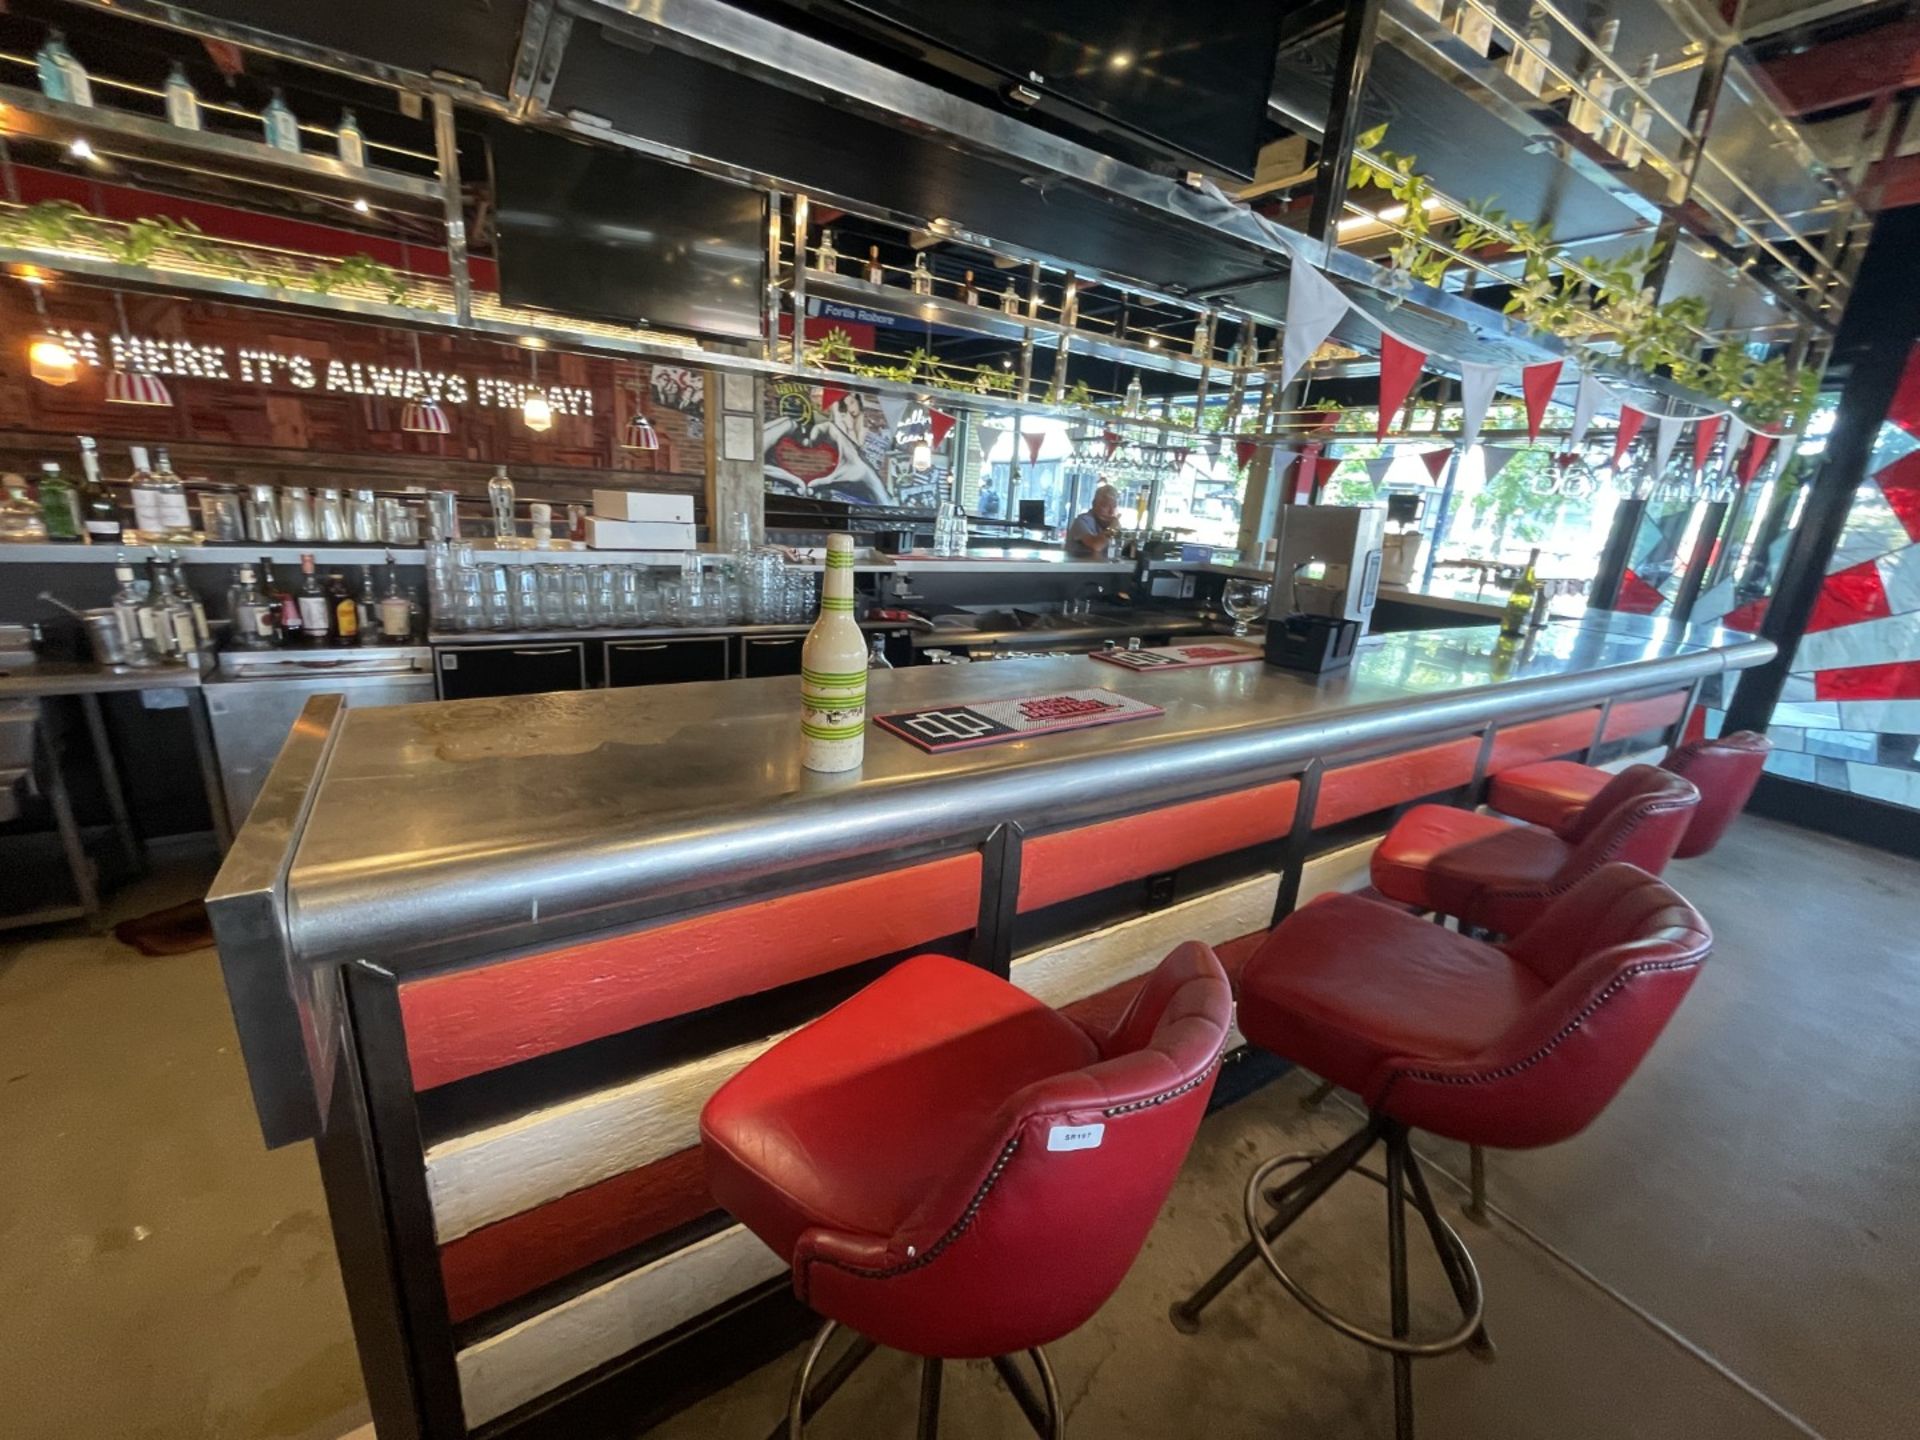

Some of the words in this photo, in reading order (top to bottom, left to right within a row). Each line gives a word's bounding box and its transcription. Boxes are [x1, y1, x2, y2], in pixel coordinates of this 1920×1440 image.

[110, 333, 229, 379] HERE
[239, 348, 316, 388] IT'S
[327, 360, 467, 403] ALWAYS
